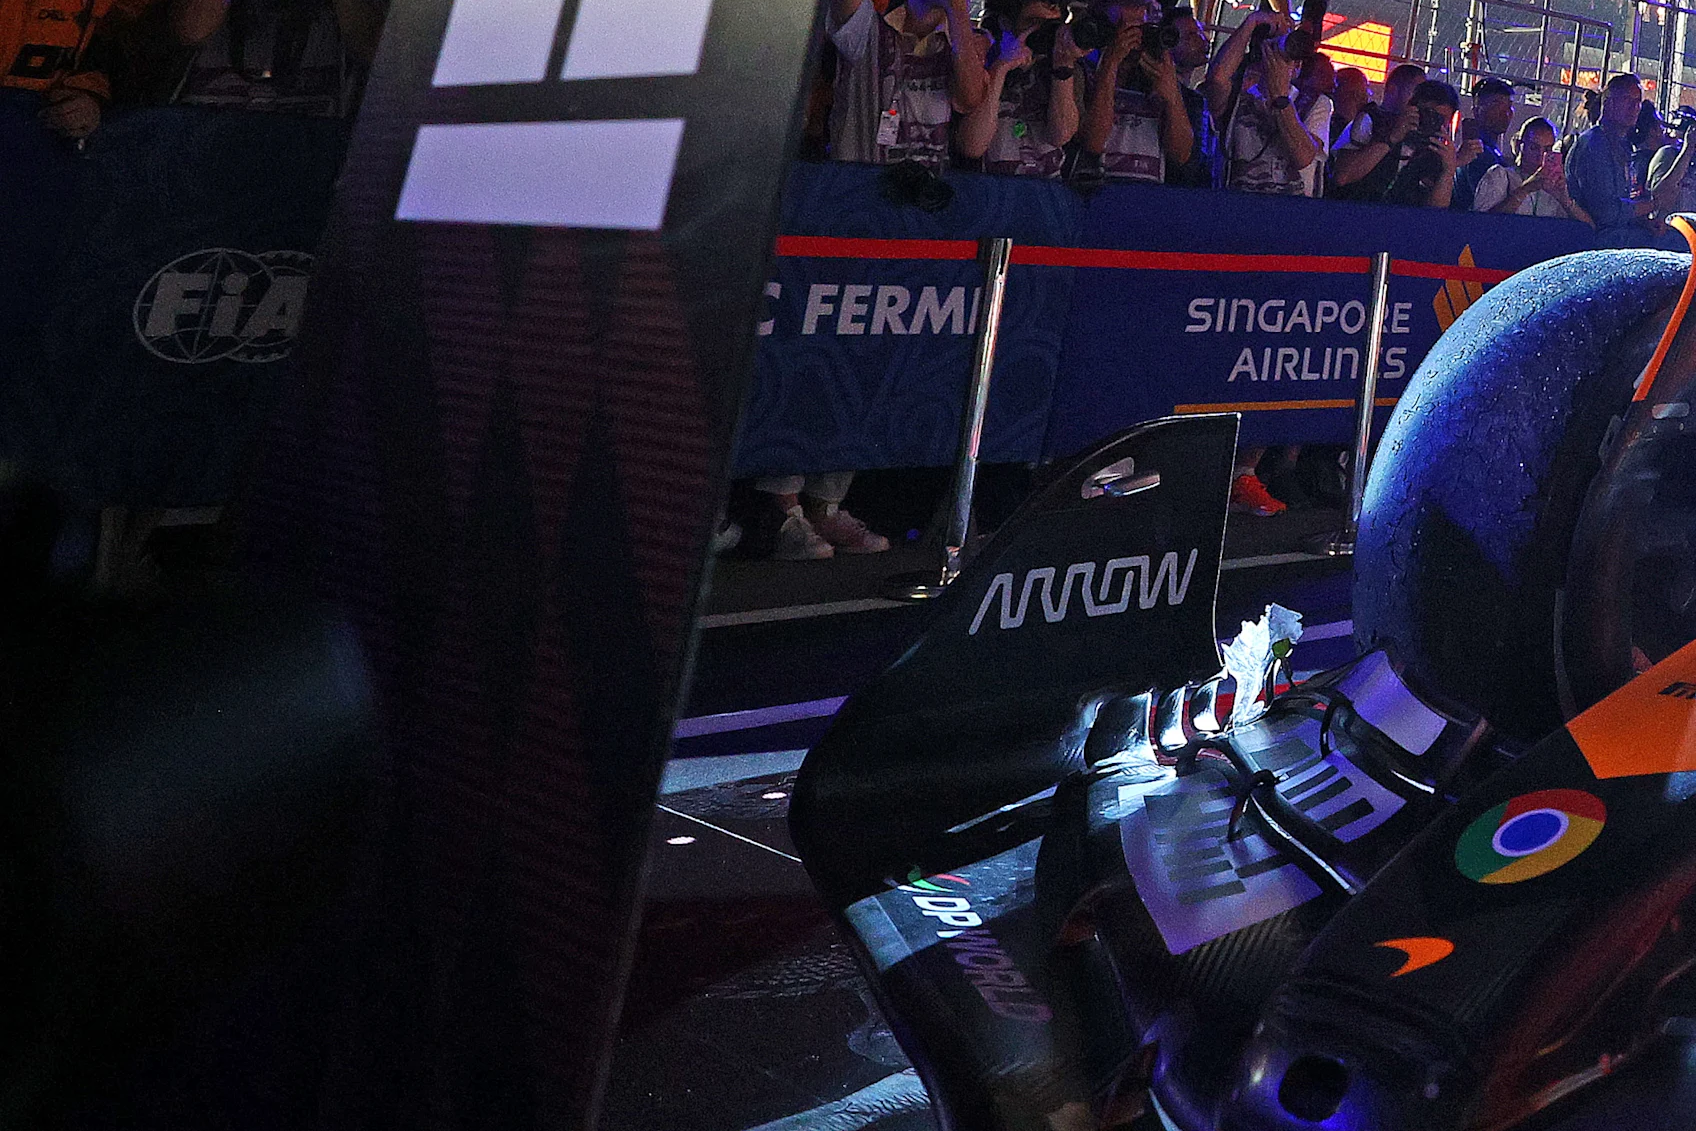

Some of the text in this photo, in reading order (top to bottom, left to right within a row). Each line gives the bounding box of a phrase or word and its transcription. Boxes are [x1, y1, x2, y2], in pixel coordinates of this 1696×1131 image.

[1226, 347, 1407, 383] AIRLINS
[969, 548, 1199, 636] ARROW
[911, 895, 1055, 1023] DP WORLD
